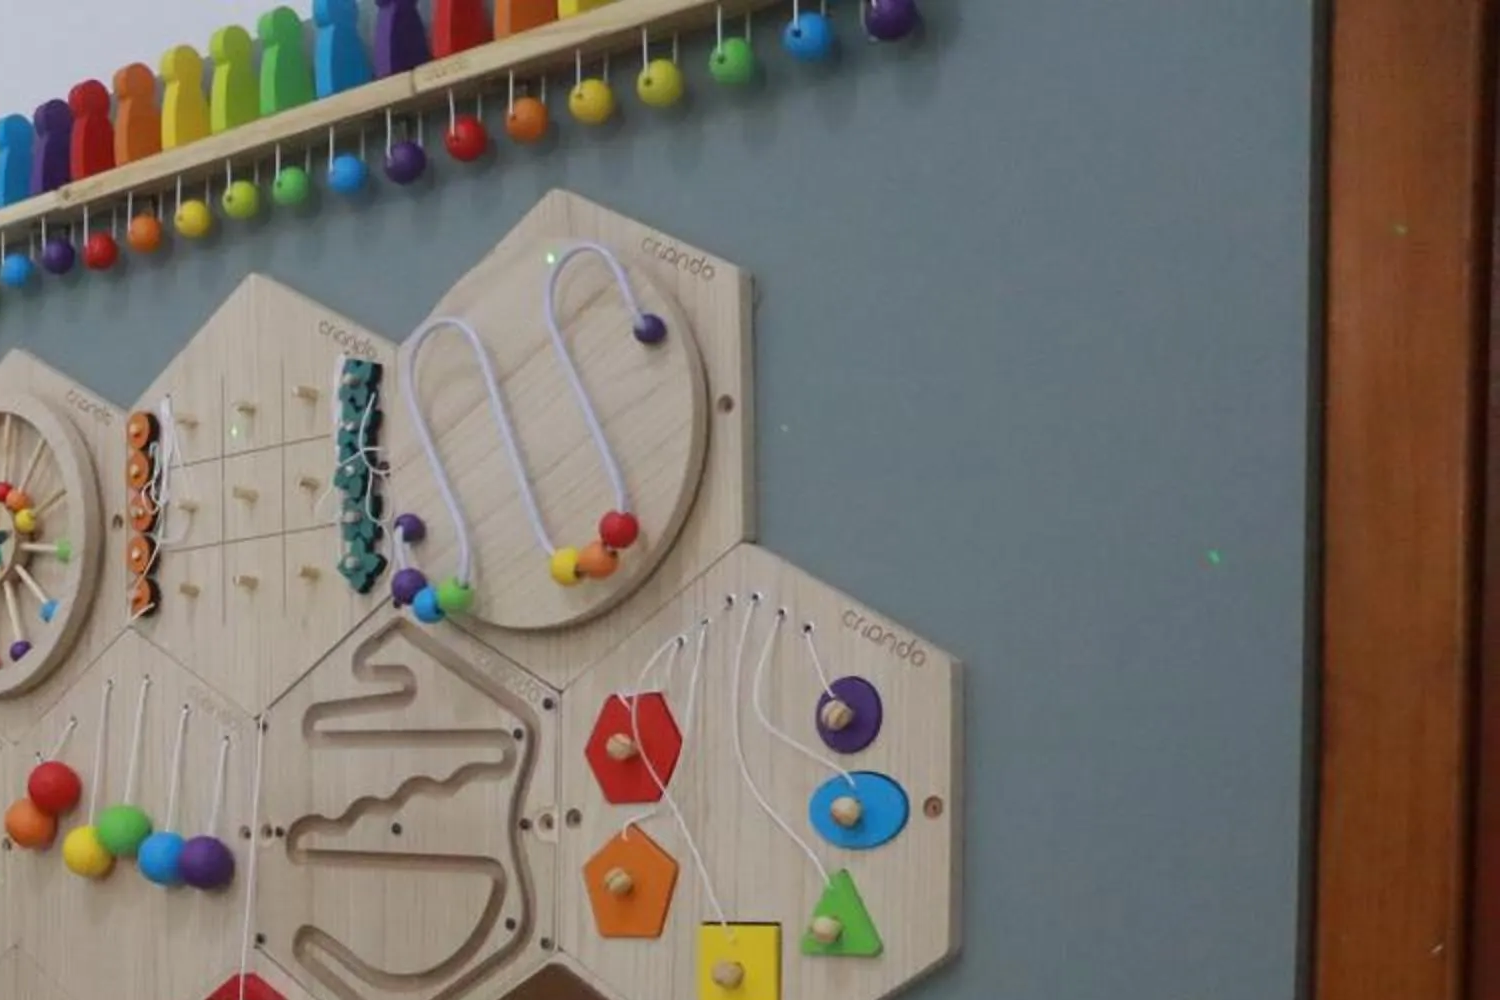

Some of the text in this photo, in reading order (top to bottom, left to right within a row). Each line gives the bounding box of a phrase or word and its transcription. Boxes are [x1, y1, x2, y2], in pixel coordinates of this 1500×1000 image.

[640, 235, 716, 281] criando
[317, 319, 378, 358] criando
[841, 608, 929, 668] criando
